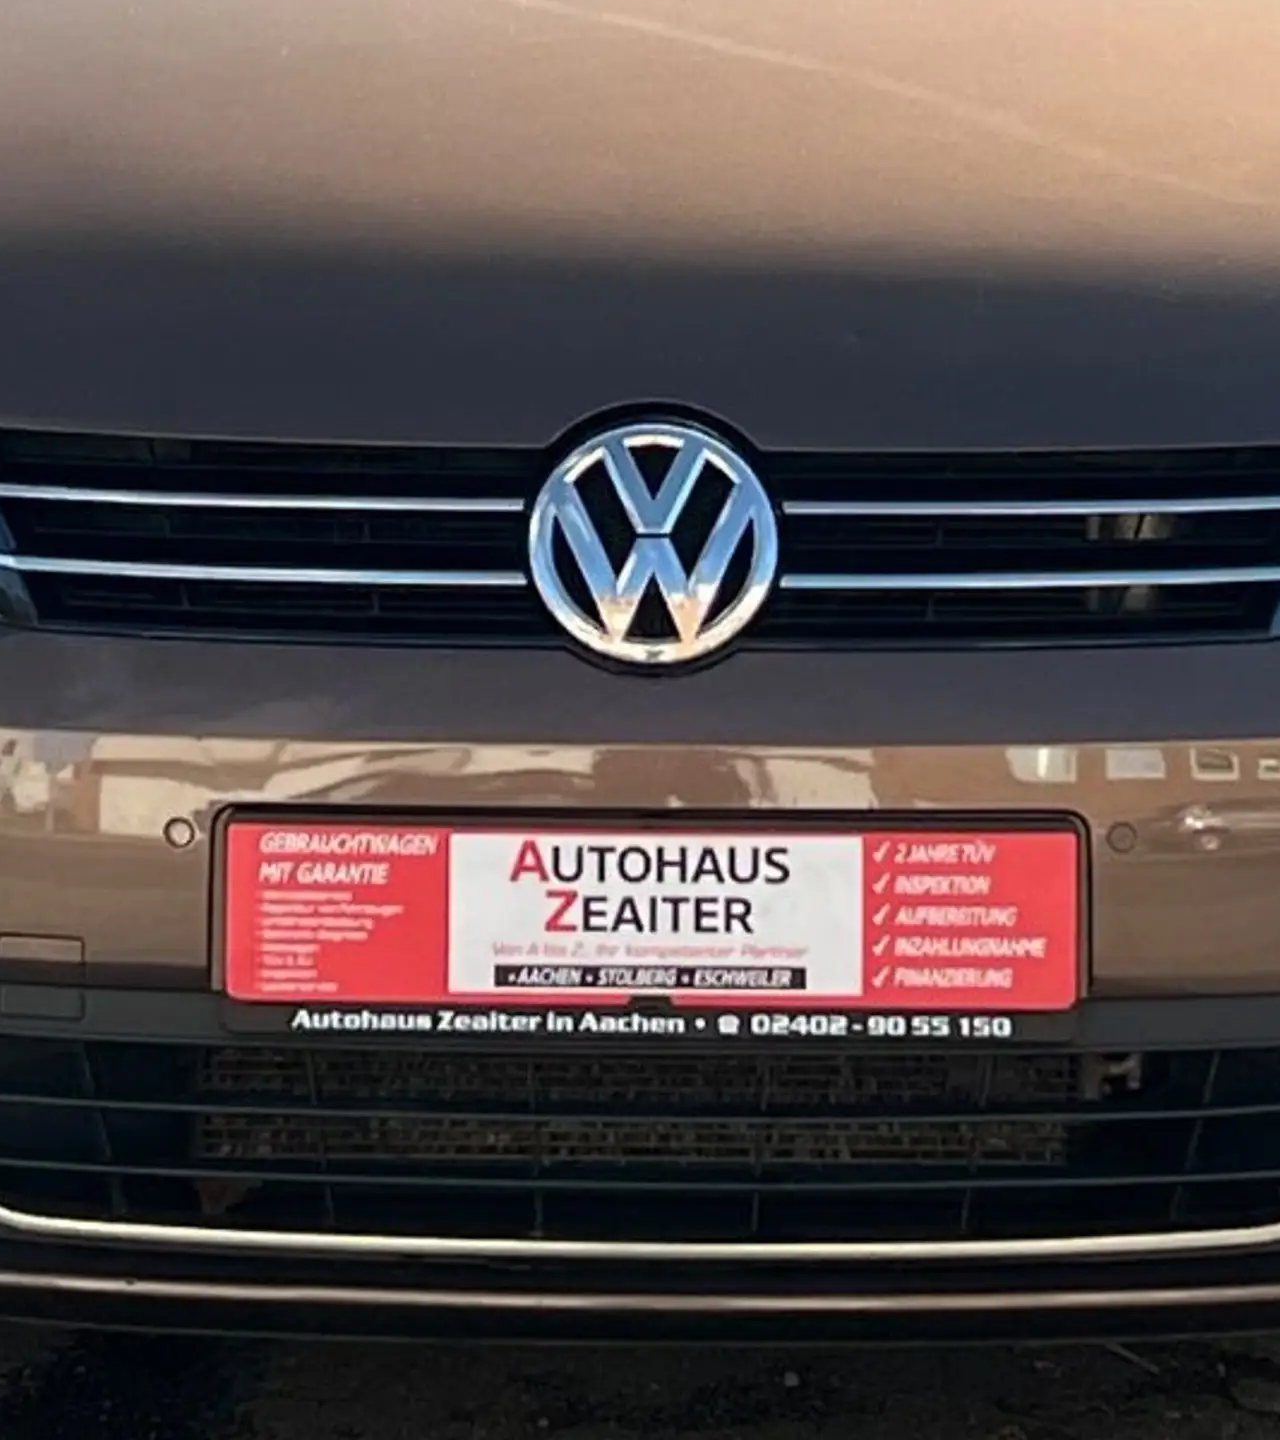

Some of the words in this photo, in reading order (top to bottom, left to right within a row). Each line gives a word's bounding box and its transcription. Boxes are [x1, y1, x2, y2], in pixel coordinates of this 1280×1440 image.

[259, 831, 439, 856] GEBRAUCHTWAGEN
[509, 838, 791, 884] AUTOHAUS
[259, 862, 294, 883] MIT
[297, 862, 391, 885] GARANTIE
[894, 875, 992, 895] INSPEKTION
[544, 889, 754, 934] ZEAITER
[894, 906, 1018, 927] AUFBEREITUNG
[517, 966, 583, 985] AACHEN
[596, 967, 677, 987] STOLBERG
[694, 968, 792, 988] ESCHWEILER
[893, 967, 1014, 988] FINANZIERUNG
[291, 1009, 432, 1031] Autohaus
[436, 1010, 541, 1032] Zeaiter
[546, 1011, 573, 1032] in
[578, 1012, 685, 1033] Aachen
[751, 1014, 848, 1036] 02402
[912, 1016, 949, 1037] 55
[959, 1016, 1012, 1038] 150
